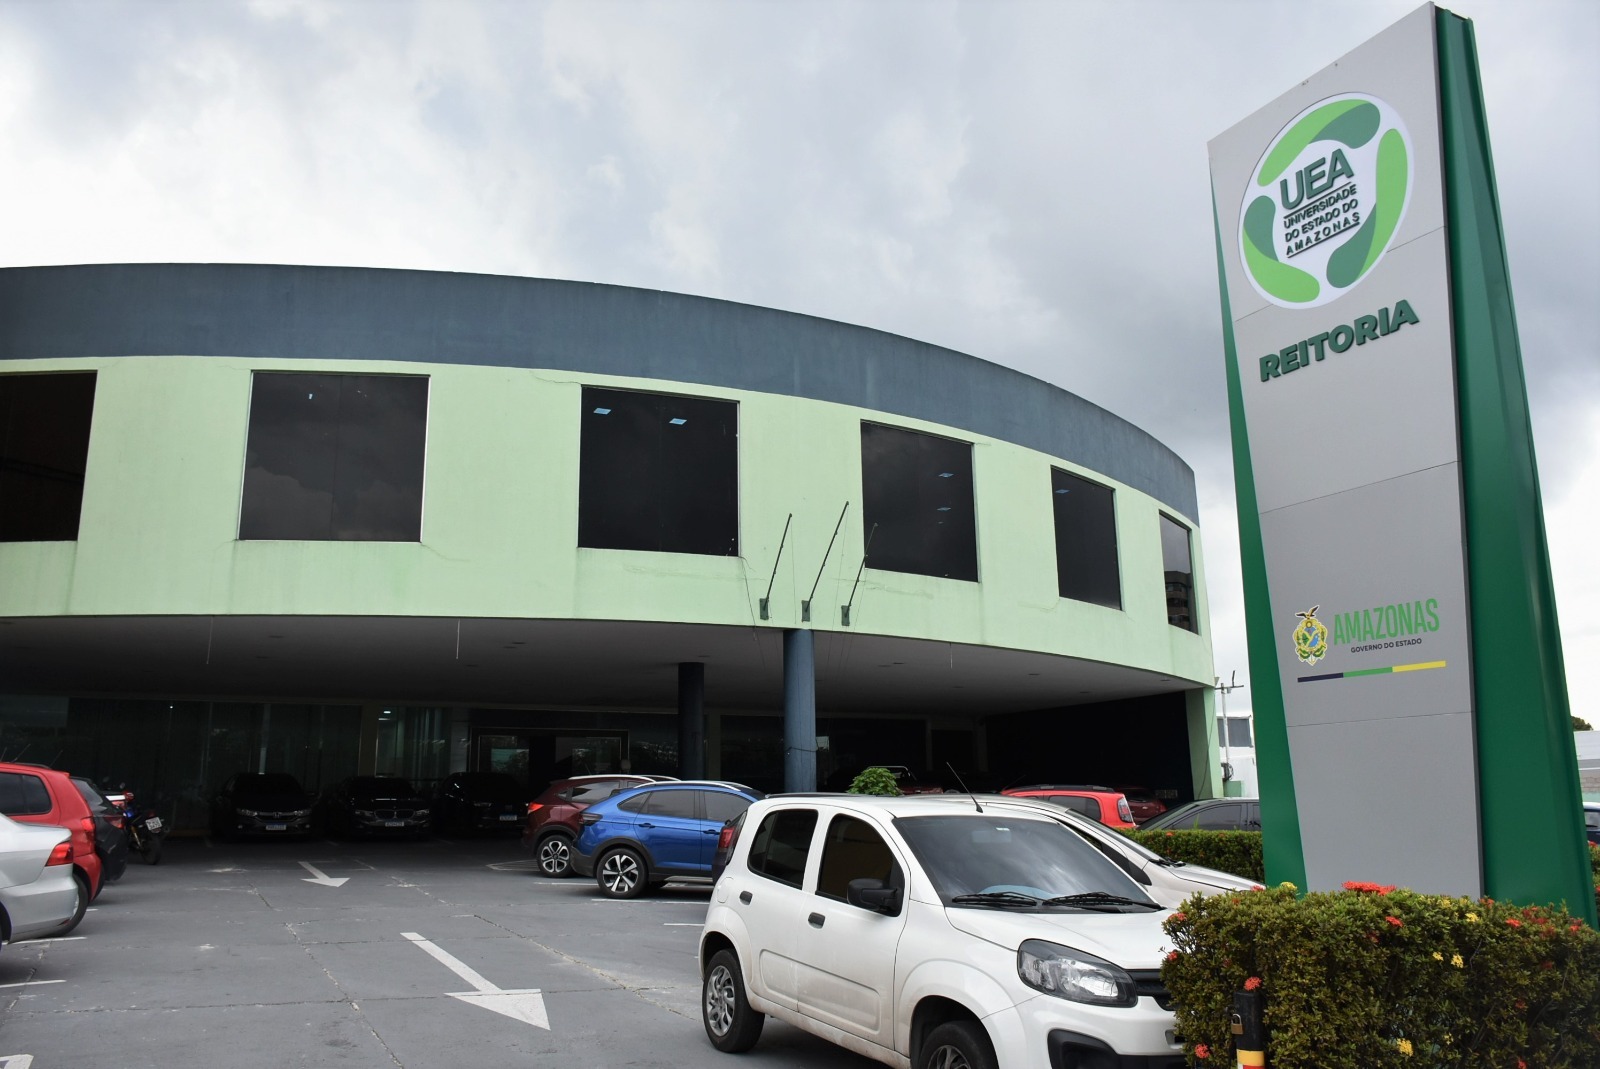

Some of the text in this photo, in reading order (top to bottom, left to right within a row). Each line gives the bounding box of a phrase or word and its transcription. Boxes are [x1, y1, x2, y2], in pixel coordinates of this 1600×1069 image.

[1280, 148, 1354, 210] UEA
[1283, 183, 1357, 229] UNIVERSIDADE
[1285, 198, 1358, 242] DO ESTADO DO
[1286, 211, 1360, 255] AMAZONAS
[1259, 299, 1420, 382] REITORIA
[1333, 598, 1440, 645] AMAZONAS
[1350, 637, 1422, 653] GOVERNO DO ESTADO
